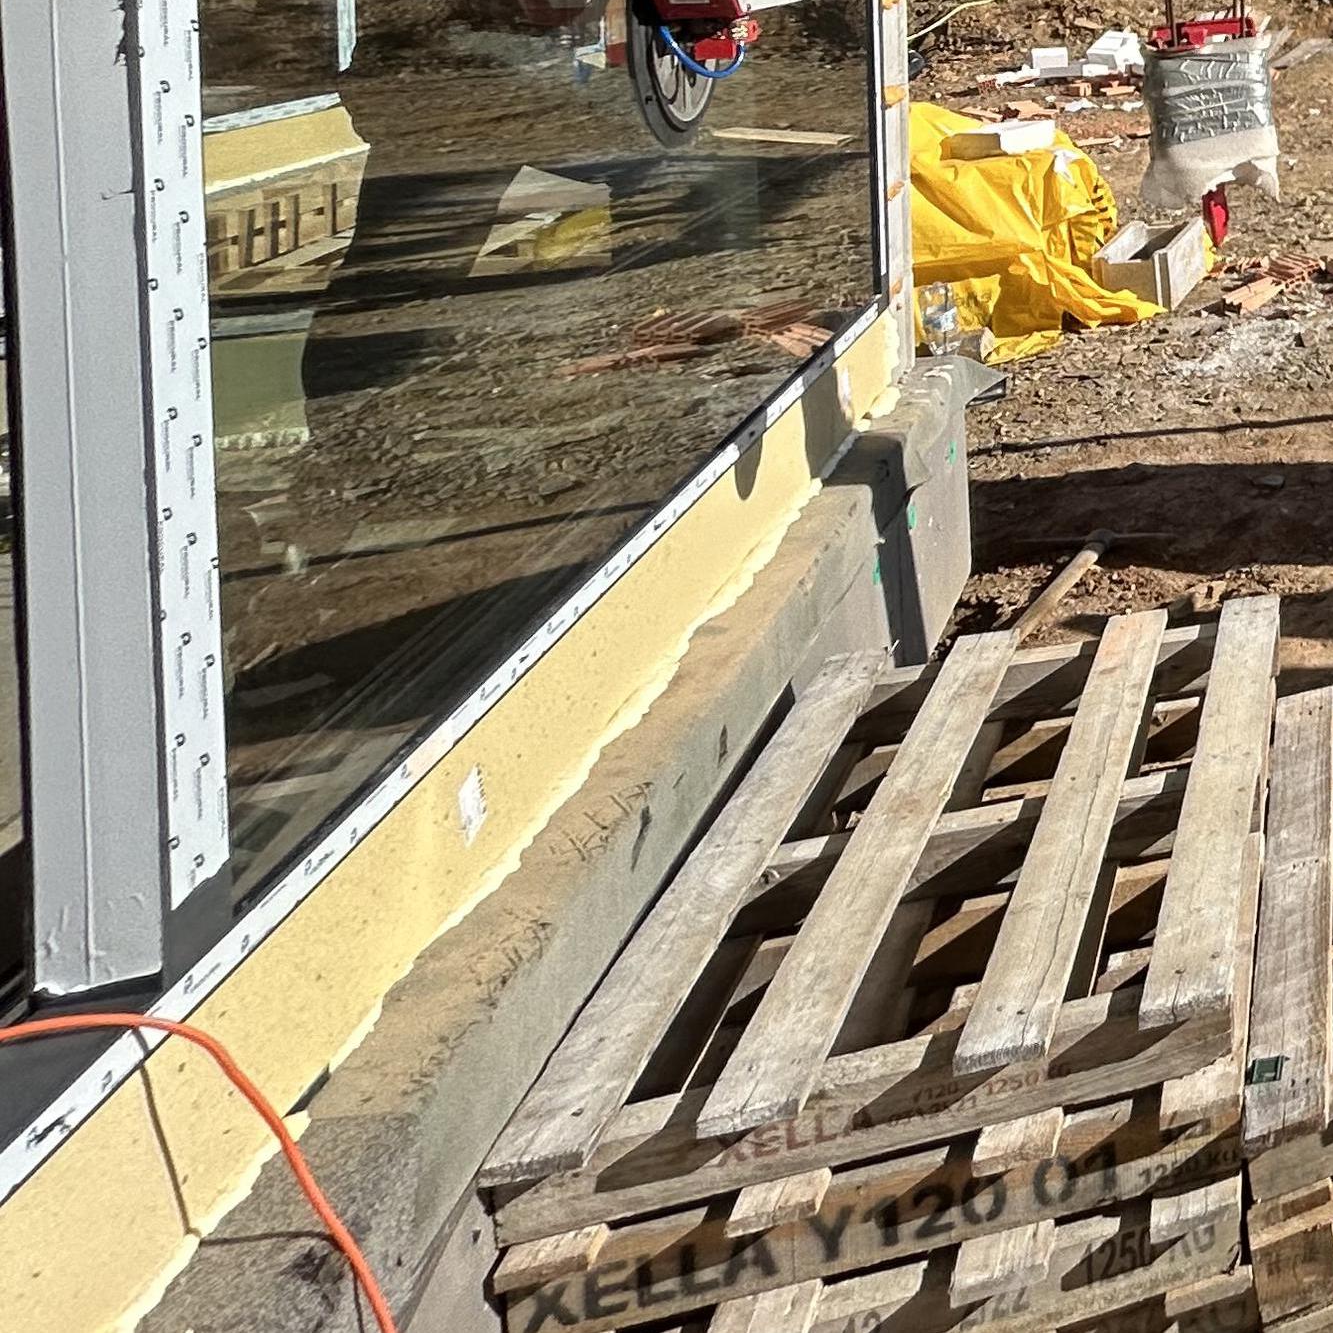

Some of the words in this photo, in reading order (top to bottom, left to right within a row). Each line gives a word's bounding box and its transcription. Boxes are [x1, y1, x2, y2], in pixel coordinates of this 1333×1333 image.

[982, 1070, 1039, 1096] 1250
[717, 1109, 873, 1168] XELLA
[524, 1235, 779, 1333] XELLA
[808, 1174, 1007, 1263] Y120
[1031, 1141, 1118, 1207] 01
